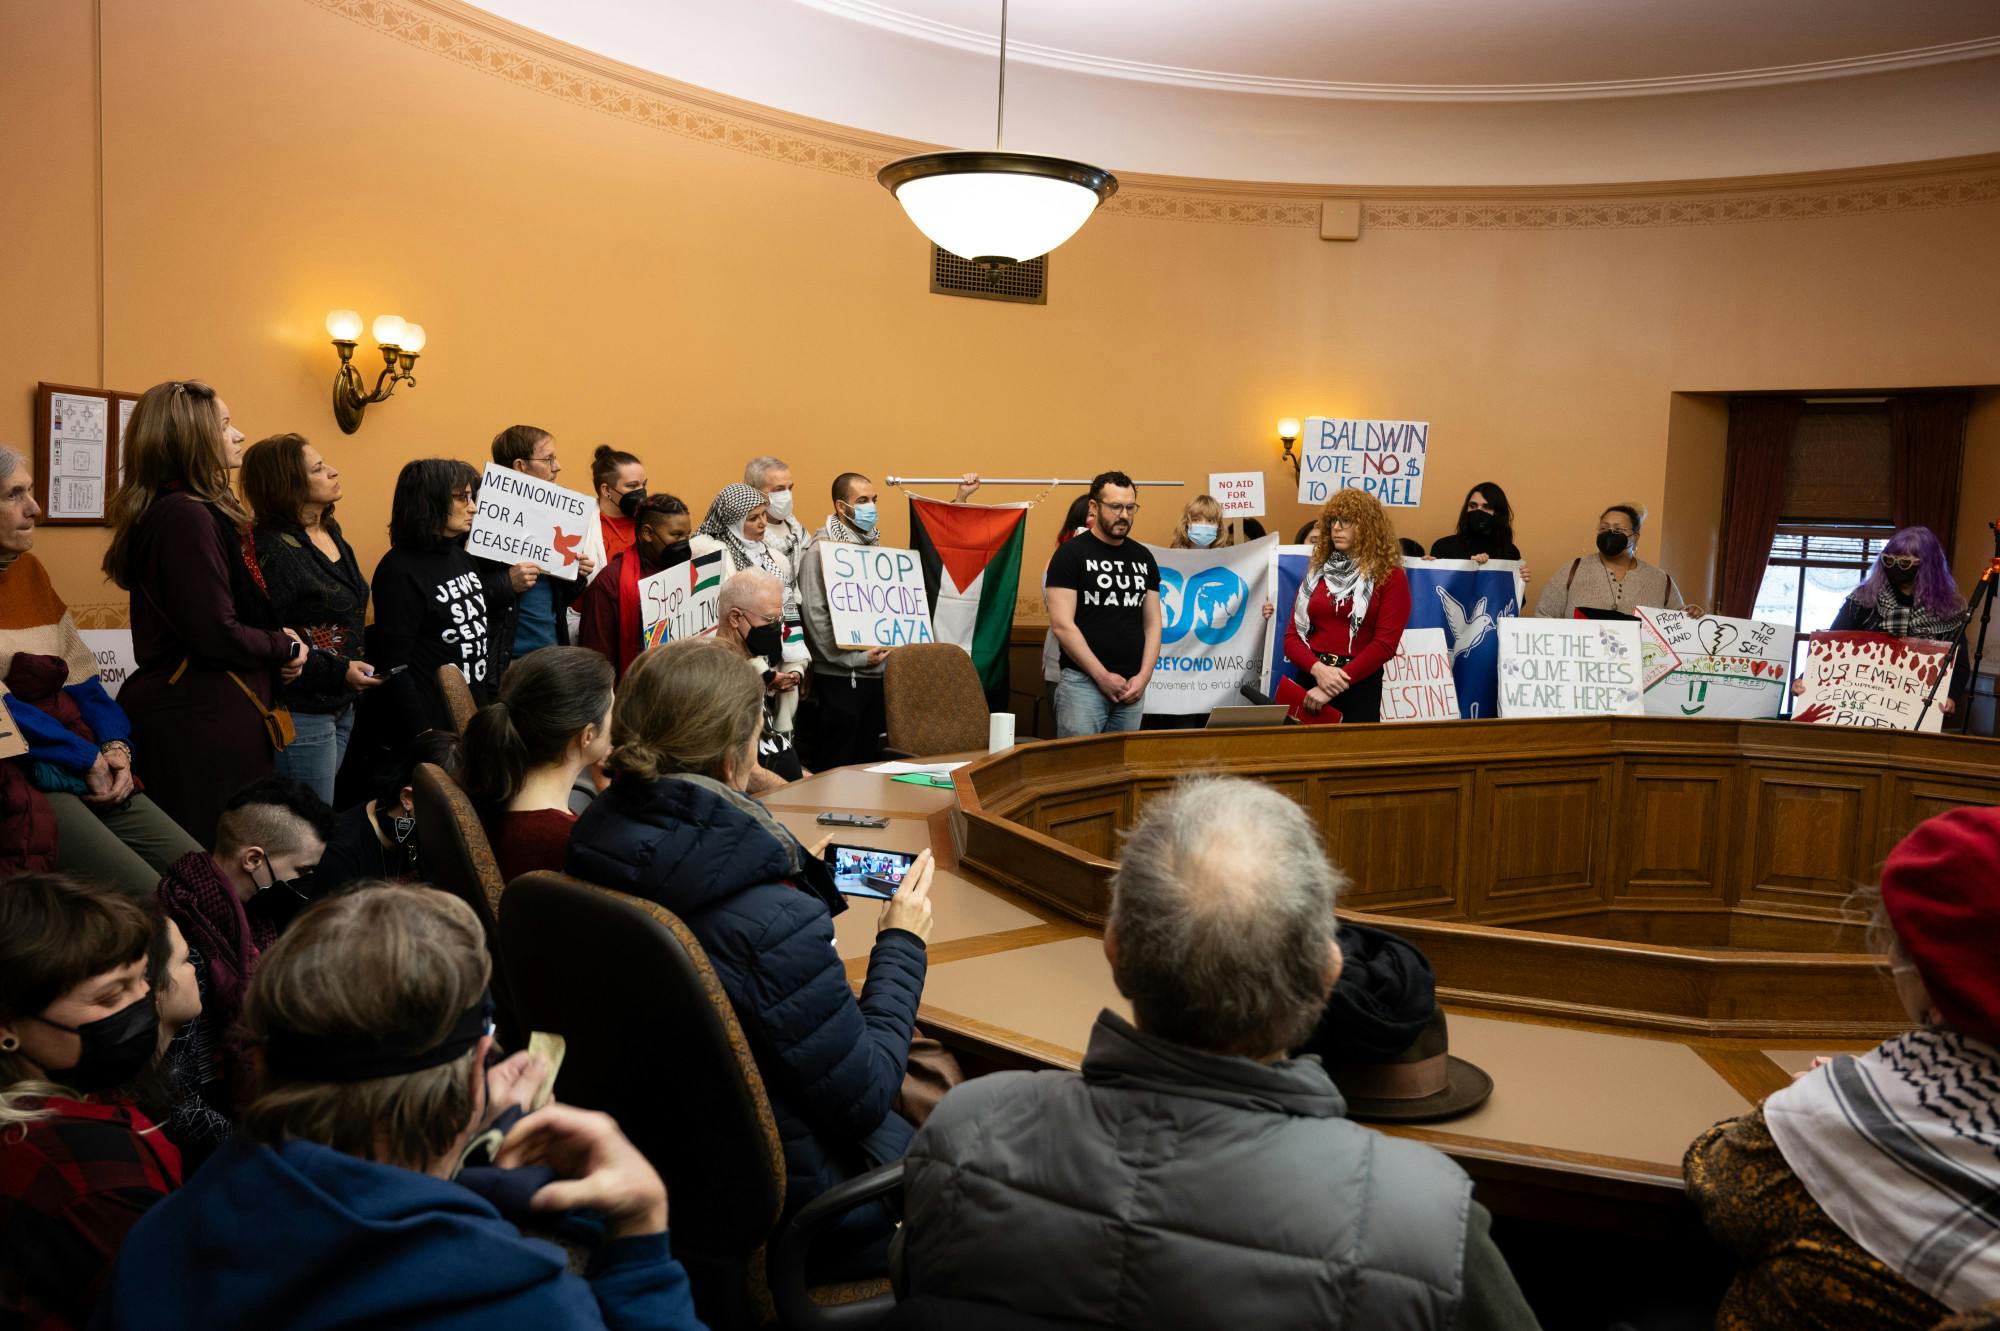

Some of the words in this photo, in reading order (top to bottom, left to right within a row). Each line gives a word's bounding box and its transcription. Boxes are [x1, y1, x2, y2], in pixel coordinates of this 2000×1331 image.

[1320, 420, 1428, 454] BALDWIN
[1306, 454, 1353, 474] VOTE
[1362, 452, 1400, 476] NO
[1404, 457, 1420, 477] $
[484, 471, 585, 516] MENNONITES
[1218, 481, 1233, 489] NO
[1236, 480, 1254, 488] AID
[1227, 490, 1247, 499] FOR
[1307, 480, 1328, 501] TO
[478, 500, 510, 523] FOR
[513, 511, 524, 527] A
[1220, 501, 1255, 510] ISRAEL
[472, 529, 551, 562] CEASEFIRE
[834, 548, 914, 582] STOP
[1086, 559, 1124, 573] NOT
[1131, 562, 1148, 575] IN
[435, 571, 482, 603] JEWS
[1096, 573, 1146, 590] OUR
[450, 593, 487, 624] SAY
[830, 582, 927, 615] GENOCIDE
[1084, 590, 1146, 607] NAM
[441, 616, 488, 644] CEA
[1656, 611, 1684, 625] FROM
[1664, 622, 1683, 634] THE
[1761, 622, 1775, 635] TO
[851, 630, 861, 643] IN
[874, 617, 932, 646] GAZA
[1668, 632, 1692, 645] LAND
[1751, 630, 1772, 645] THE
[1558, 633, 1595, 658] THE
[1739, 641, 1763, 656] SEA
[99, 667, 127, 683] SOM
[1382, 652, 1453, 682] UPATION
[1521, 659, 1571, 682] OLIVE
[1573, 660, 1634, 685] TREES
[1817, 663, 1850, 683] US
[1149, 680, 1195, 691] movement
[1198, 680, 1208, 691] to
[1210, 680, 1231, 690] end
[1504, 682, 1532, 707] WE
[1532, 684, 1566, 709] ARE
[1380, 683, 1459, 720] LESTINE
[1816, 688, 1910, 716] GENOCIDE
